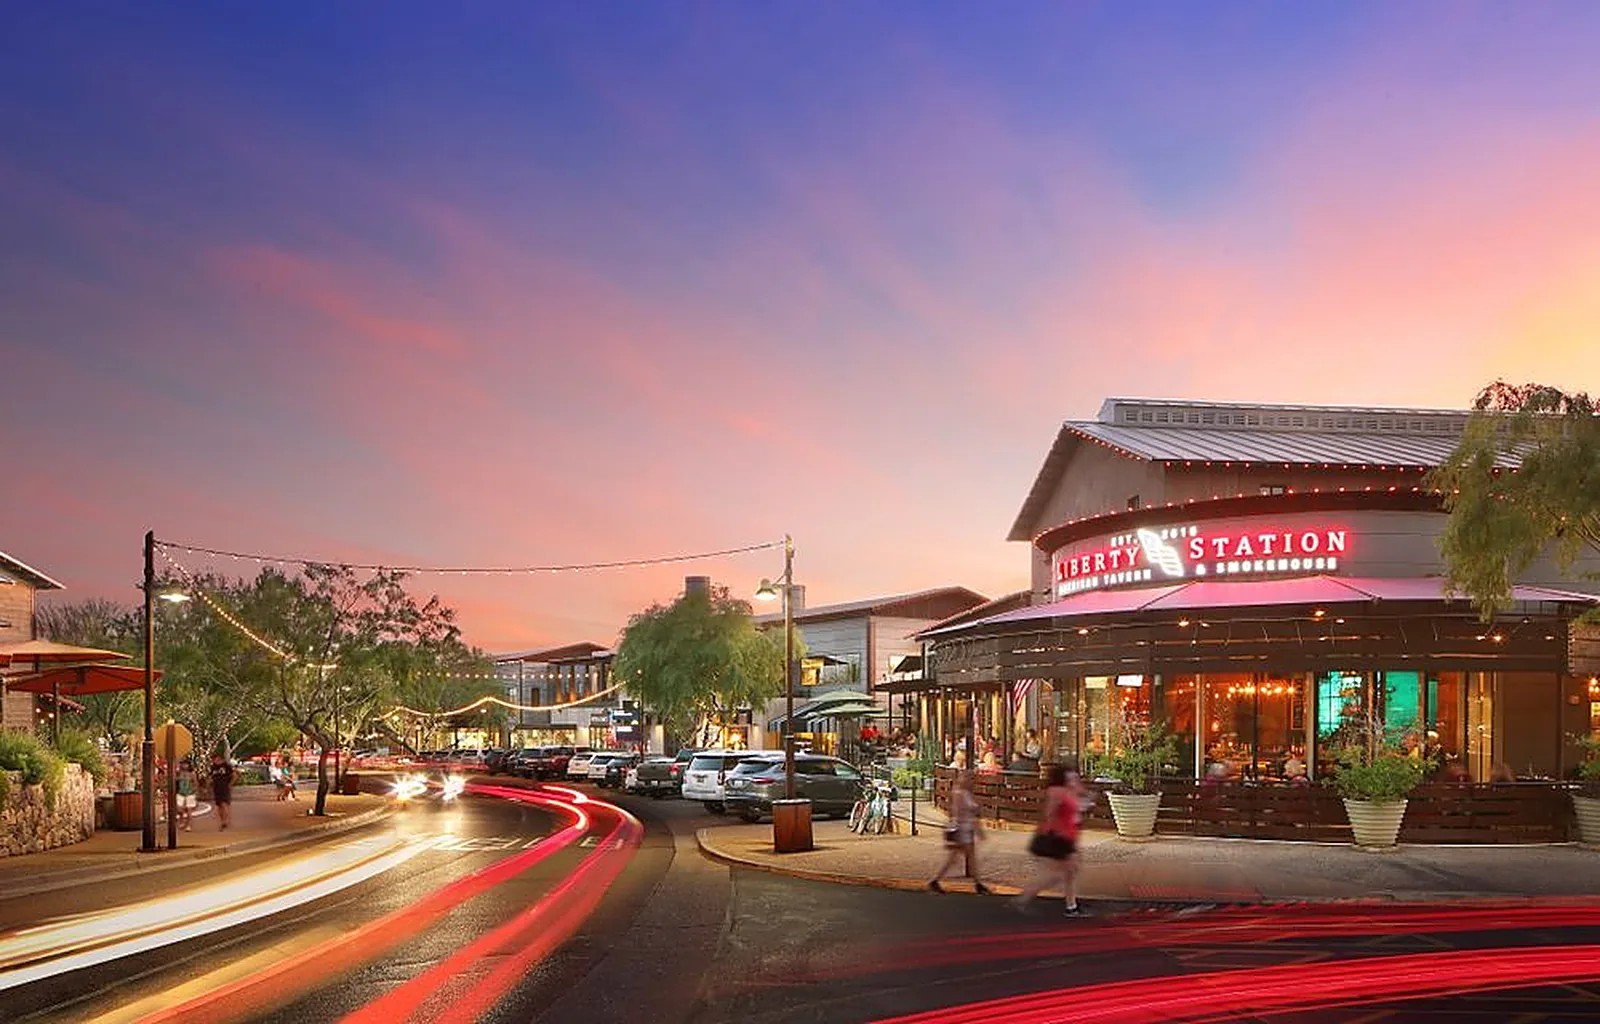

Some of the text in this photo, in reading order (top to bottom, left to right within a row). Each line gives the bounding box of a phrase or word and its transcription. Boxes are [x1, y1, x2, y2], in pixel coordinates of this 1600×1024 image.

[1111, 534, 1138, 547] EST.
[1057, 531, 1345, 580] LIBERTY STATION
[1103, 569, 1151, 585] TAVERN
[1195, 563, 1206, 575] &
[1216, 557, 1337, 574] SMOKEHOUSE
